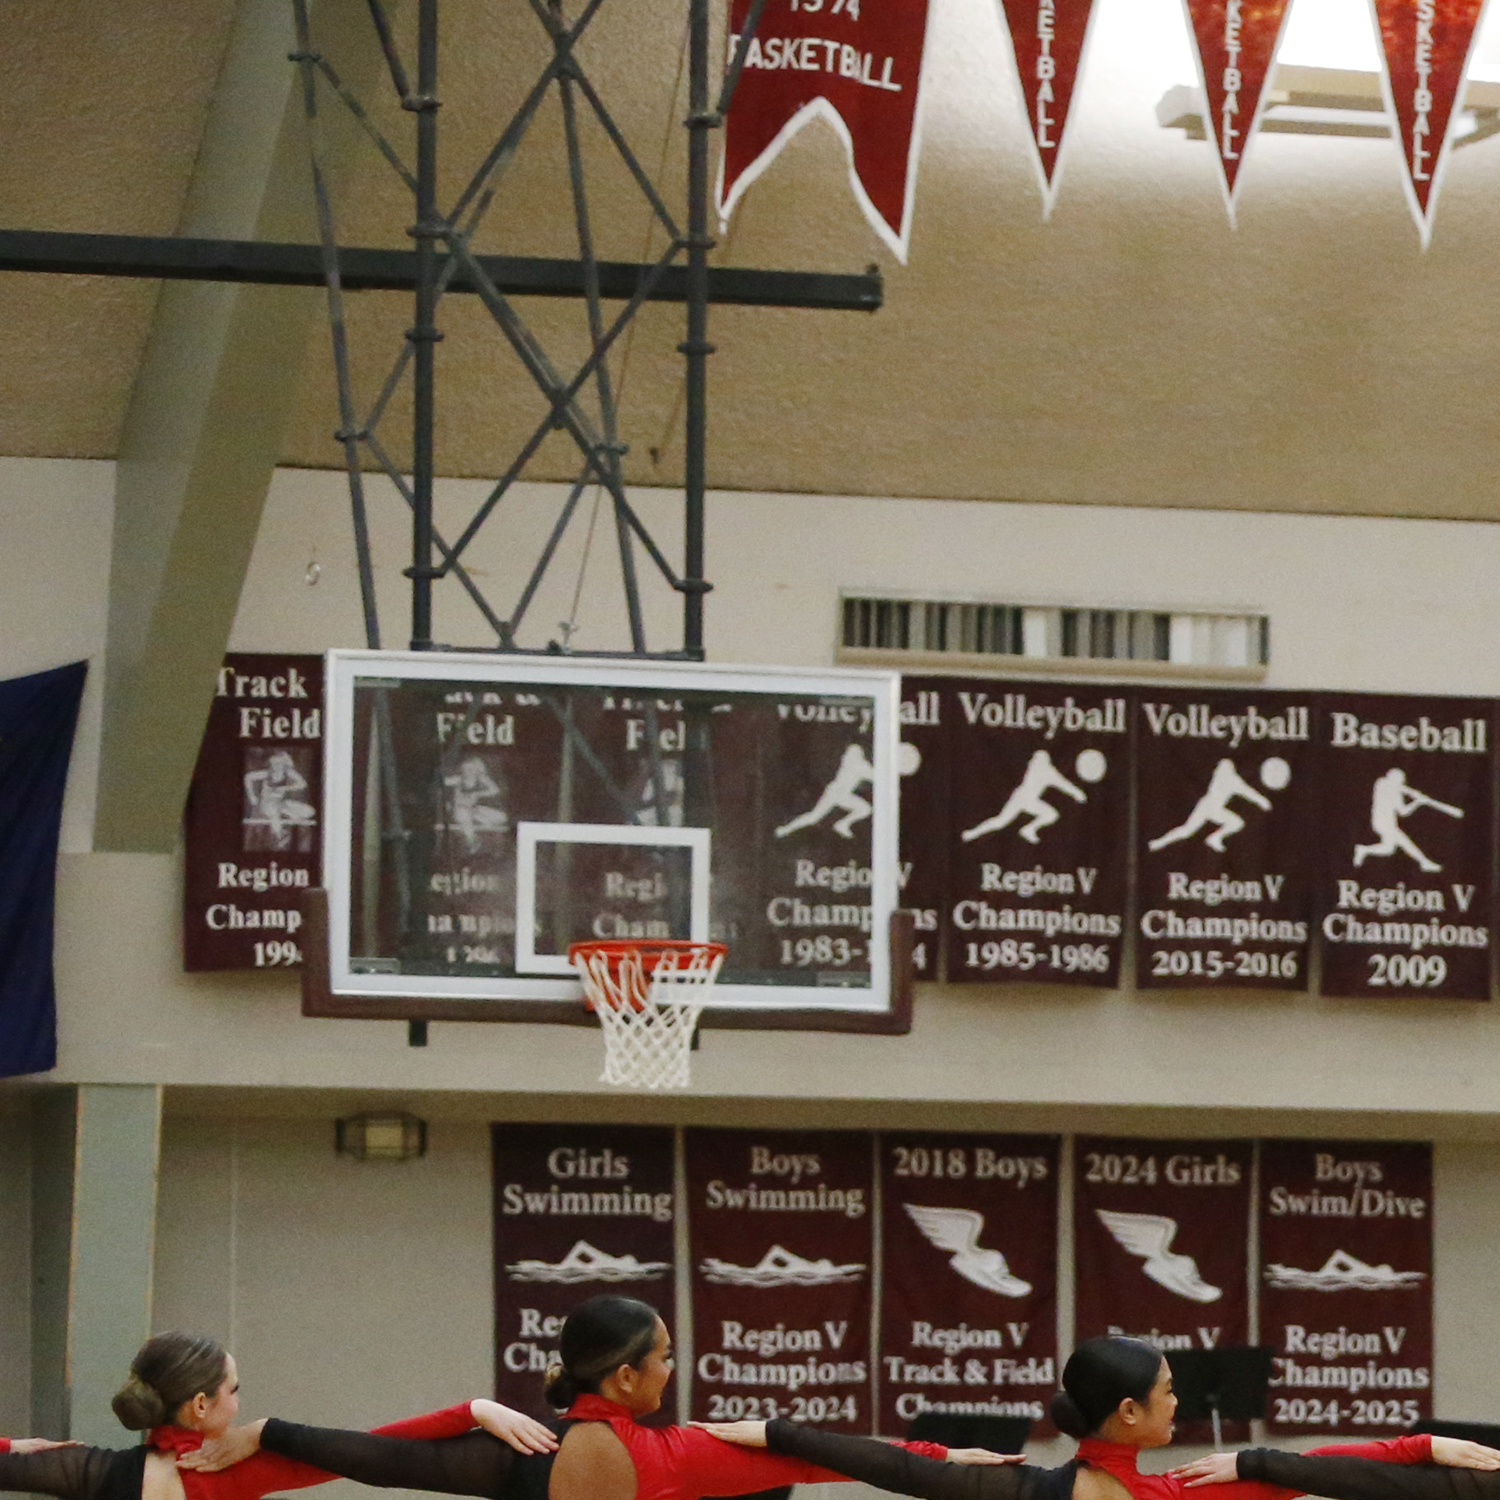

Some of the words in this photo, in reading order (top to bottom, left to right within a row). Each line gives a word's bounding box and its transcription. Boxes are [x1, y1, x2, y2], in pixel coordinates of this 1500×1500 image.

[216, 667, 308, 699] Track
[239, 707, 321, 739] Field
[437, 713, 515, 746] Feld
[958, 692, 1126, 738] Volleyball
[1143, 703, 1309, 748] Volleyball
[1331, 712, 1488, 754] Baseball
[218, 862, 310, 891] Region
[980, 862, 1074, 897] Region
[1076, 868, 1097, 894] V
[1168, 872, 1263, 906] Region
[1264, 875, 1285, 901] V
[1338, 880, 1445, 916] Region
[1452, 884, 1475, 912] V
[205, 904, 302, 933] Champ
[953, 901, 1121, 936] Champions
[1141, 910, 1308, 945] Champions
[1322, 914, 1489, 948] Champions
[253, 940, 303, 967] 199
[966, 942, 1110, 973] 1985-1986
[1151, 951, 1298, 979] 2015-2016
[1367, 955, 1447, 987] 2009
[547, 1147, 629, 1180] Girls
[750, 1147, 821, 1184] Boys
[895, 1148, 966, 1177] 2018
[975, 1148, 1048, 1187] Boys
[1085, 1152, 1158, 1184] 2024
[1165, 1153, 1241, 1185] Girls
[1314, 1153, 1383, 1186] Boys
[503, 1184, 673, 1222] Swimming
[706, 1181, 865, 1218] Swimming
[1269, 1186, 1425, 1219] Swim/Dive
[721, 1321, 820, 1354] Region
[825, 1321, 848, 1349] V
[911, 1321, 1001, 1354] Region
[1006, 1322, 1029, 1348] V
[1198, 1327, 1220, 1350] V
[1285, 1325, 1379, 1357] Region
[1383, 1326, 1407, 1354] V
[698, 1354, 866, 1389] Champions
[886, 1357, 965, 1384] Track
[966, 1358, 988, 1385] &
[994, 1357, 1054, 1386] Field
[1268, 1359, 1430, 1391] Champions
[708, 1394, 858, 1423] 2023-2024
[1273, 1399, 1420, 1425] 2024-2025
